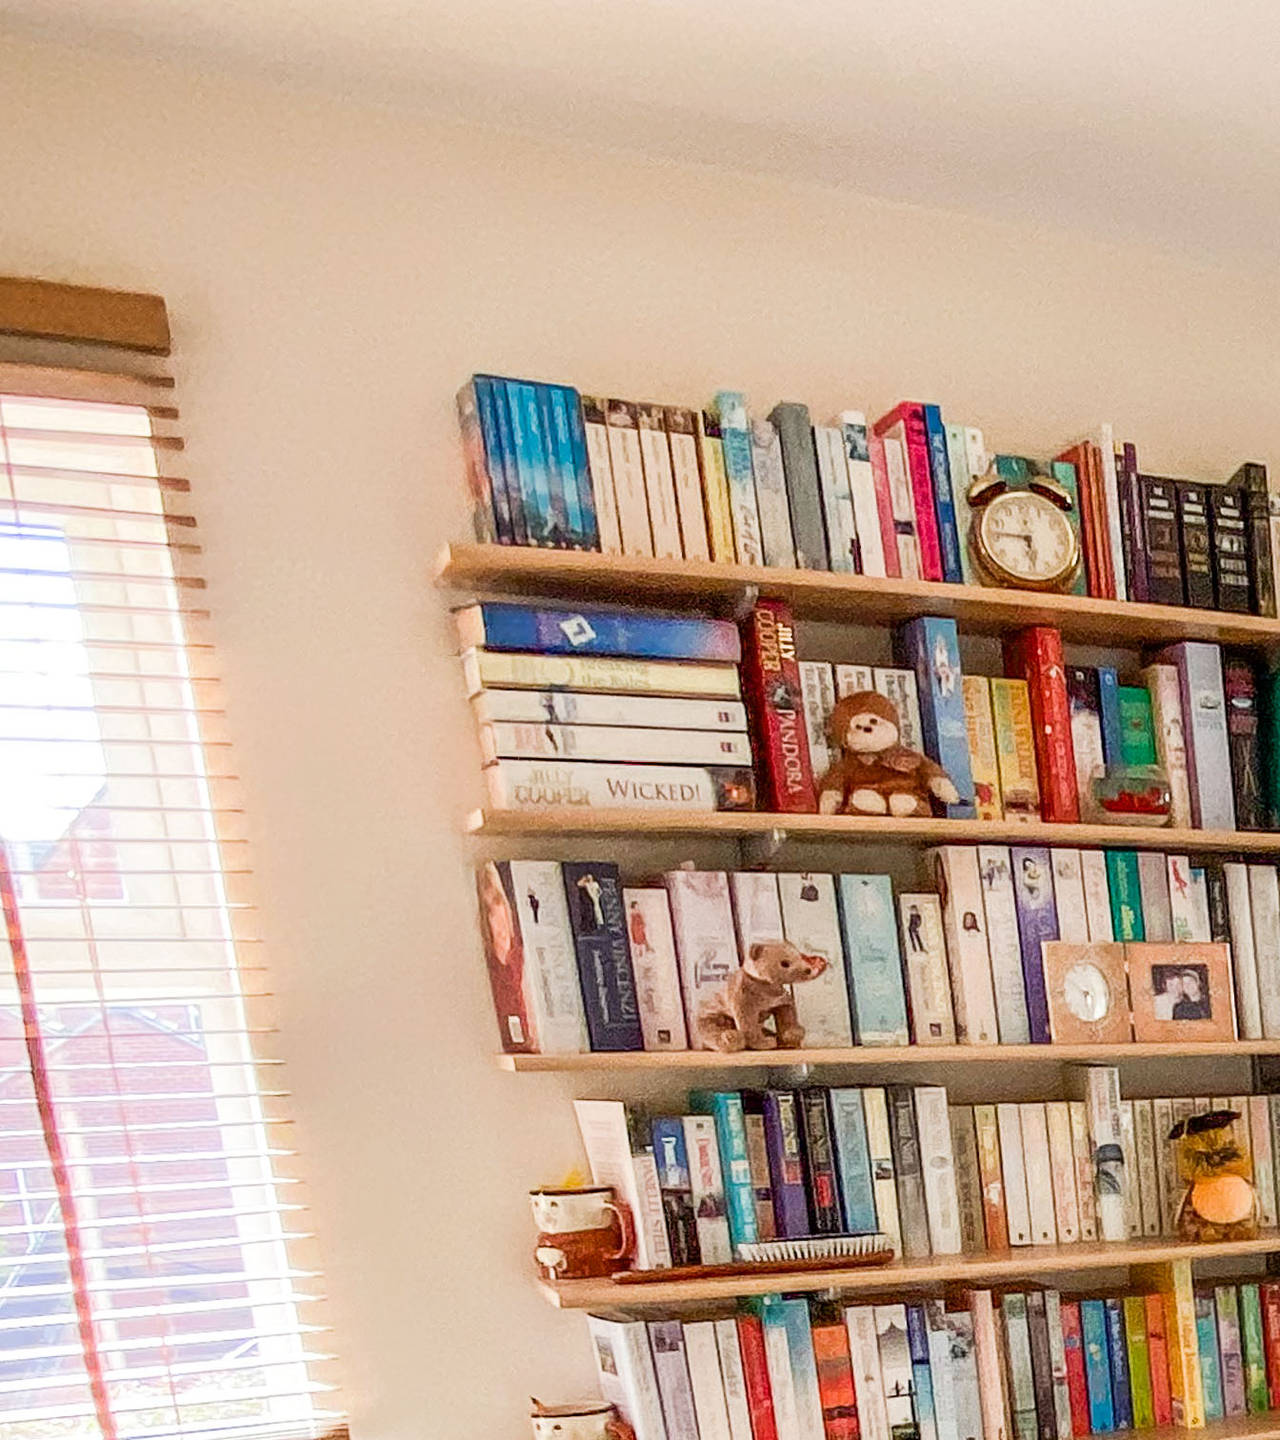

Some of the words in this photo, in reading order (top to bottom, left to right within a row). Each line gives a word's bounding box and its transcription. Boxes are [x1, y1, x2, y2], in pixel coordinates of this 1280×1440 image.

[777, 622, 796, 662] JILLY
[776, 709, 804, 794] PANDORA
[606, 777, 700, 803] WICKED!
